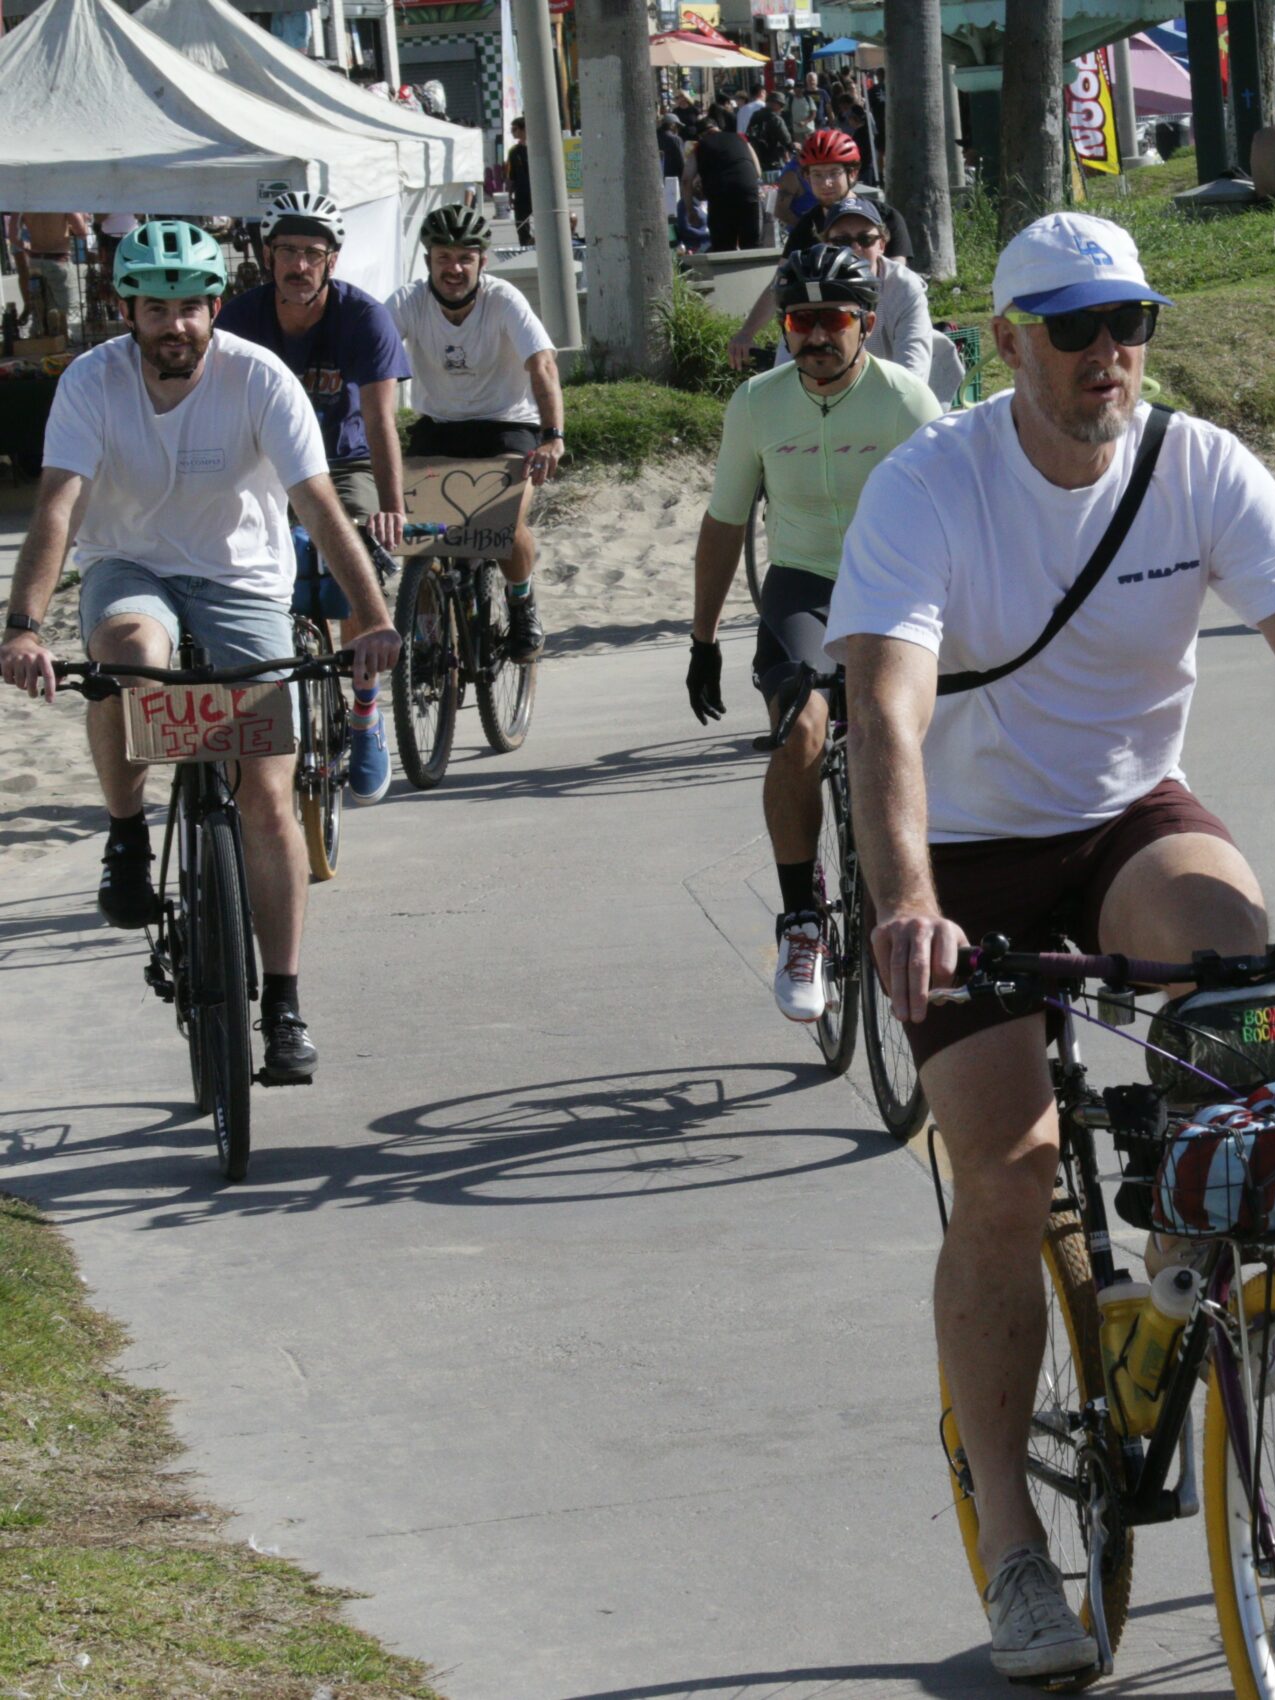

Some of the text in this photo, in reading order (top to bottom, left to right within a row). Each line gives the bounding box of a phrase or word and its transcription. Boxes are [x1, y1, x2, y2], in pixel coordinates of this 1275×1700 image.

[1072, 236, 1114, 266] LA
[776, 444, 878, 454] MAAP
[139, 689, 258, 725] FUCK
[162, 718, 274, 757] ICE
